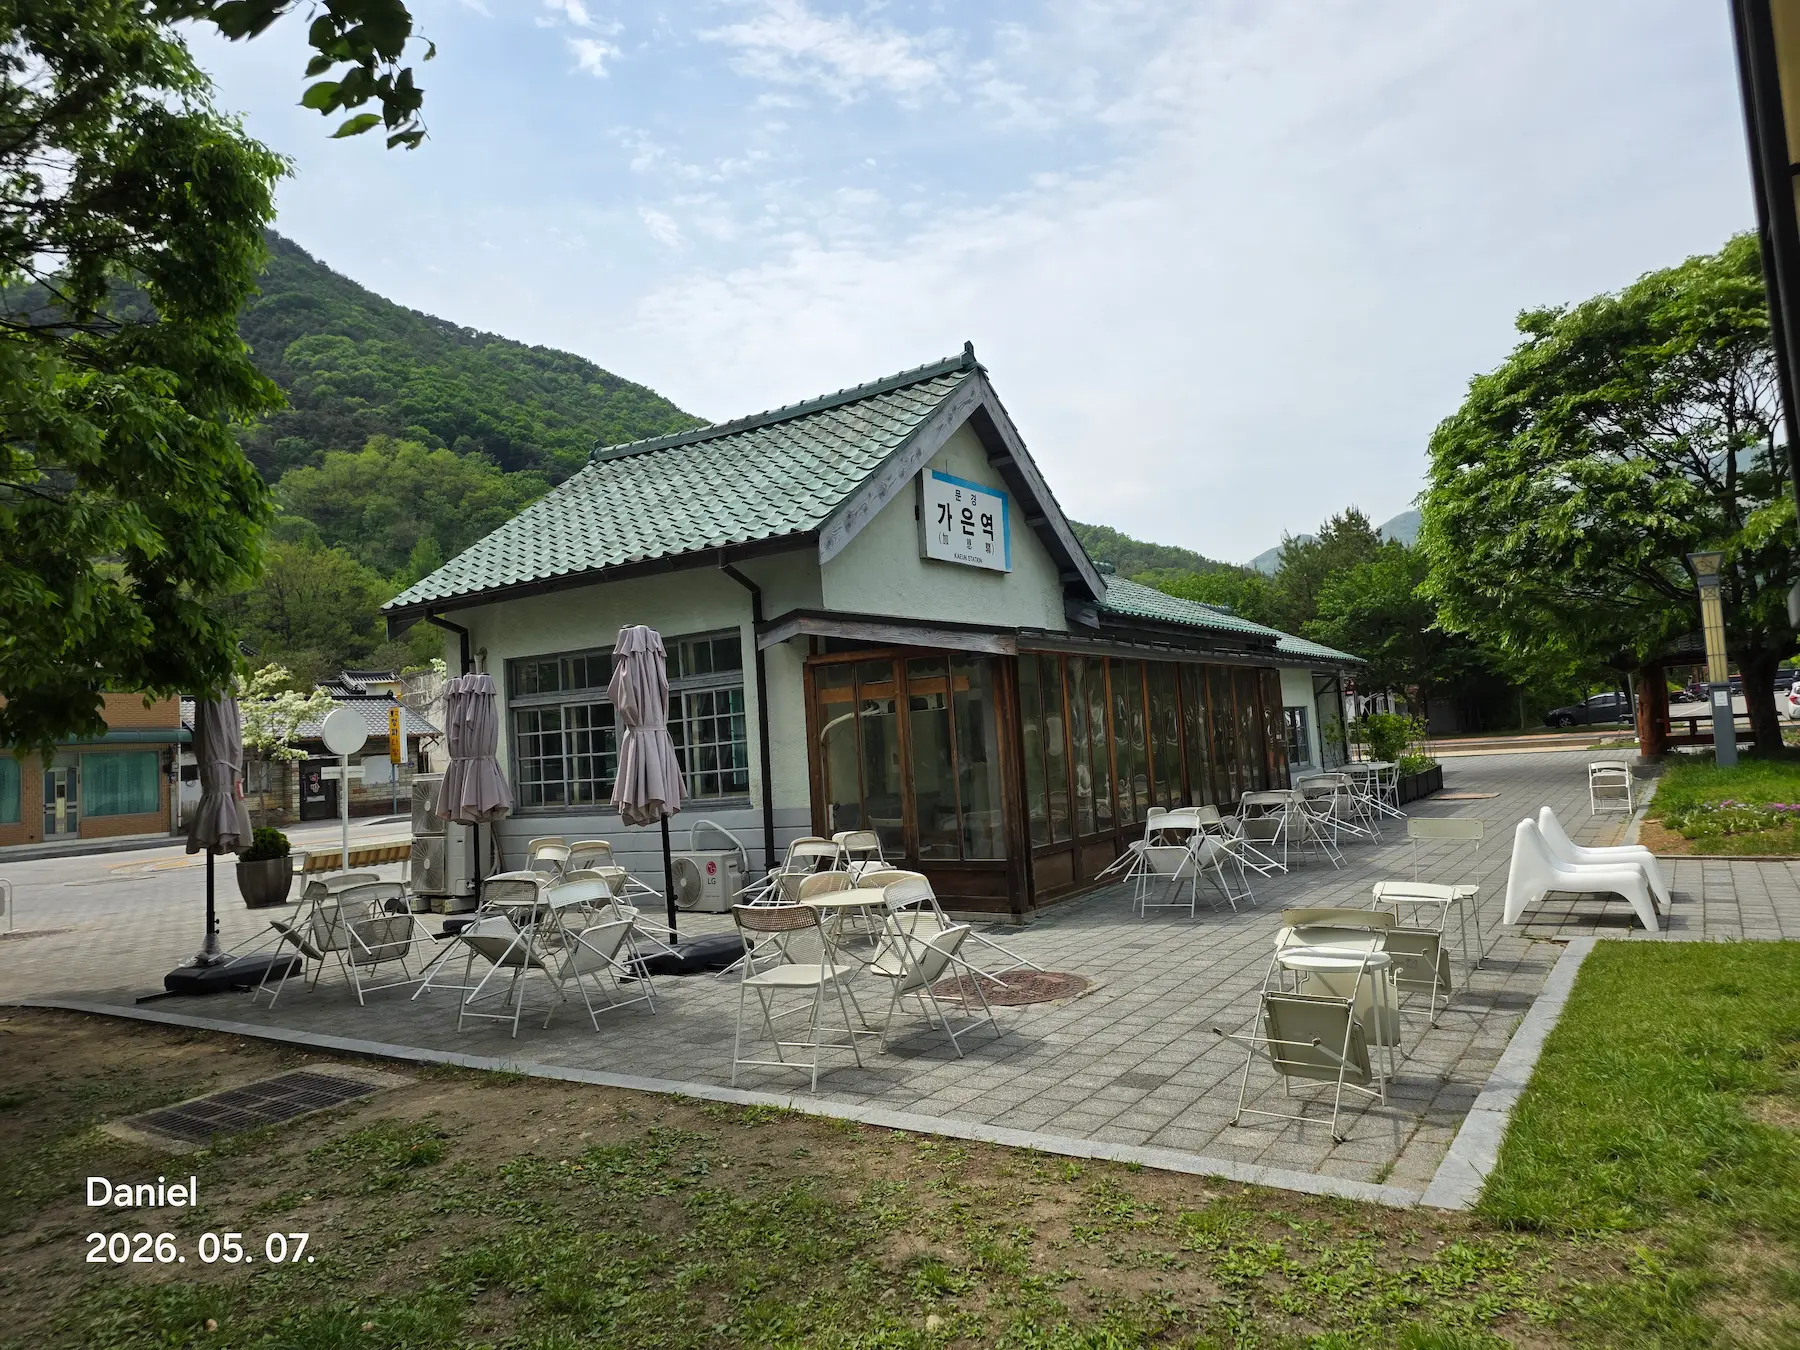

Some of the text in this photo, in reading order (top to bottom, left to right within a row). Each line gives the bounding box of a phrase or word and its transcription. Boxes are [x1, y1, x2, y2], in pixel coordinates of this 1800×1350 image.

[954, 489, 977, 506] 문경
[937, 502, 994, 541] 가은역
[707, 877, 717, 885] LG
